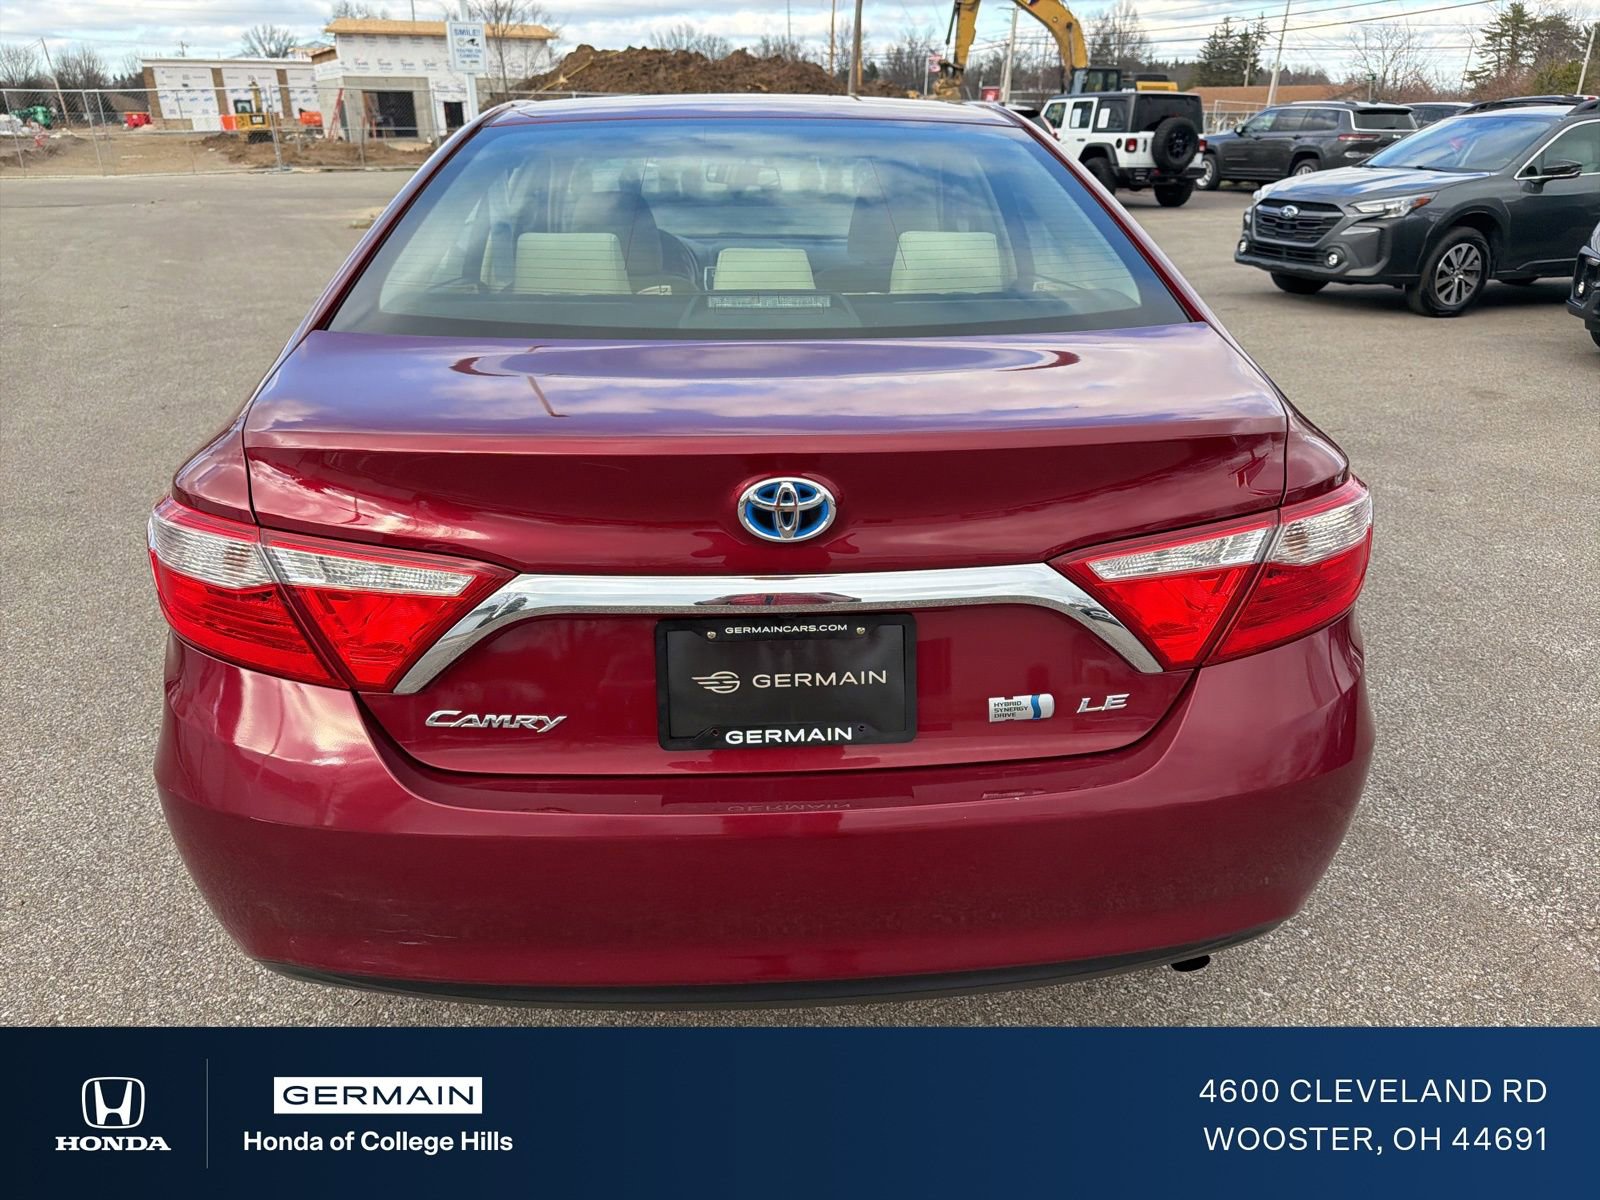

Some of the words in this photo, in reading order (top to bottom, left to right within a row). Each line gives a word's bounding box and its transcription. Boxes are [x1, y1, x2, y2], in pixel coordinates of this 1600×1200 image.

[724, 624, 848, 635] GERMAINCARS.COM
[752, 669, 887, 689] GERMAIN
[1076, 693, 1130, 714] LE
[725, 726, 853, 745] GERMAIN
